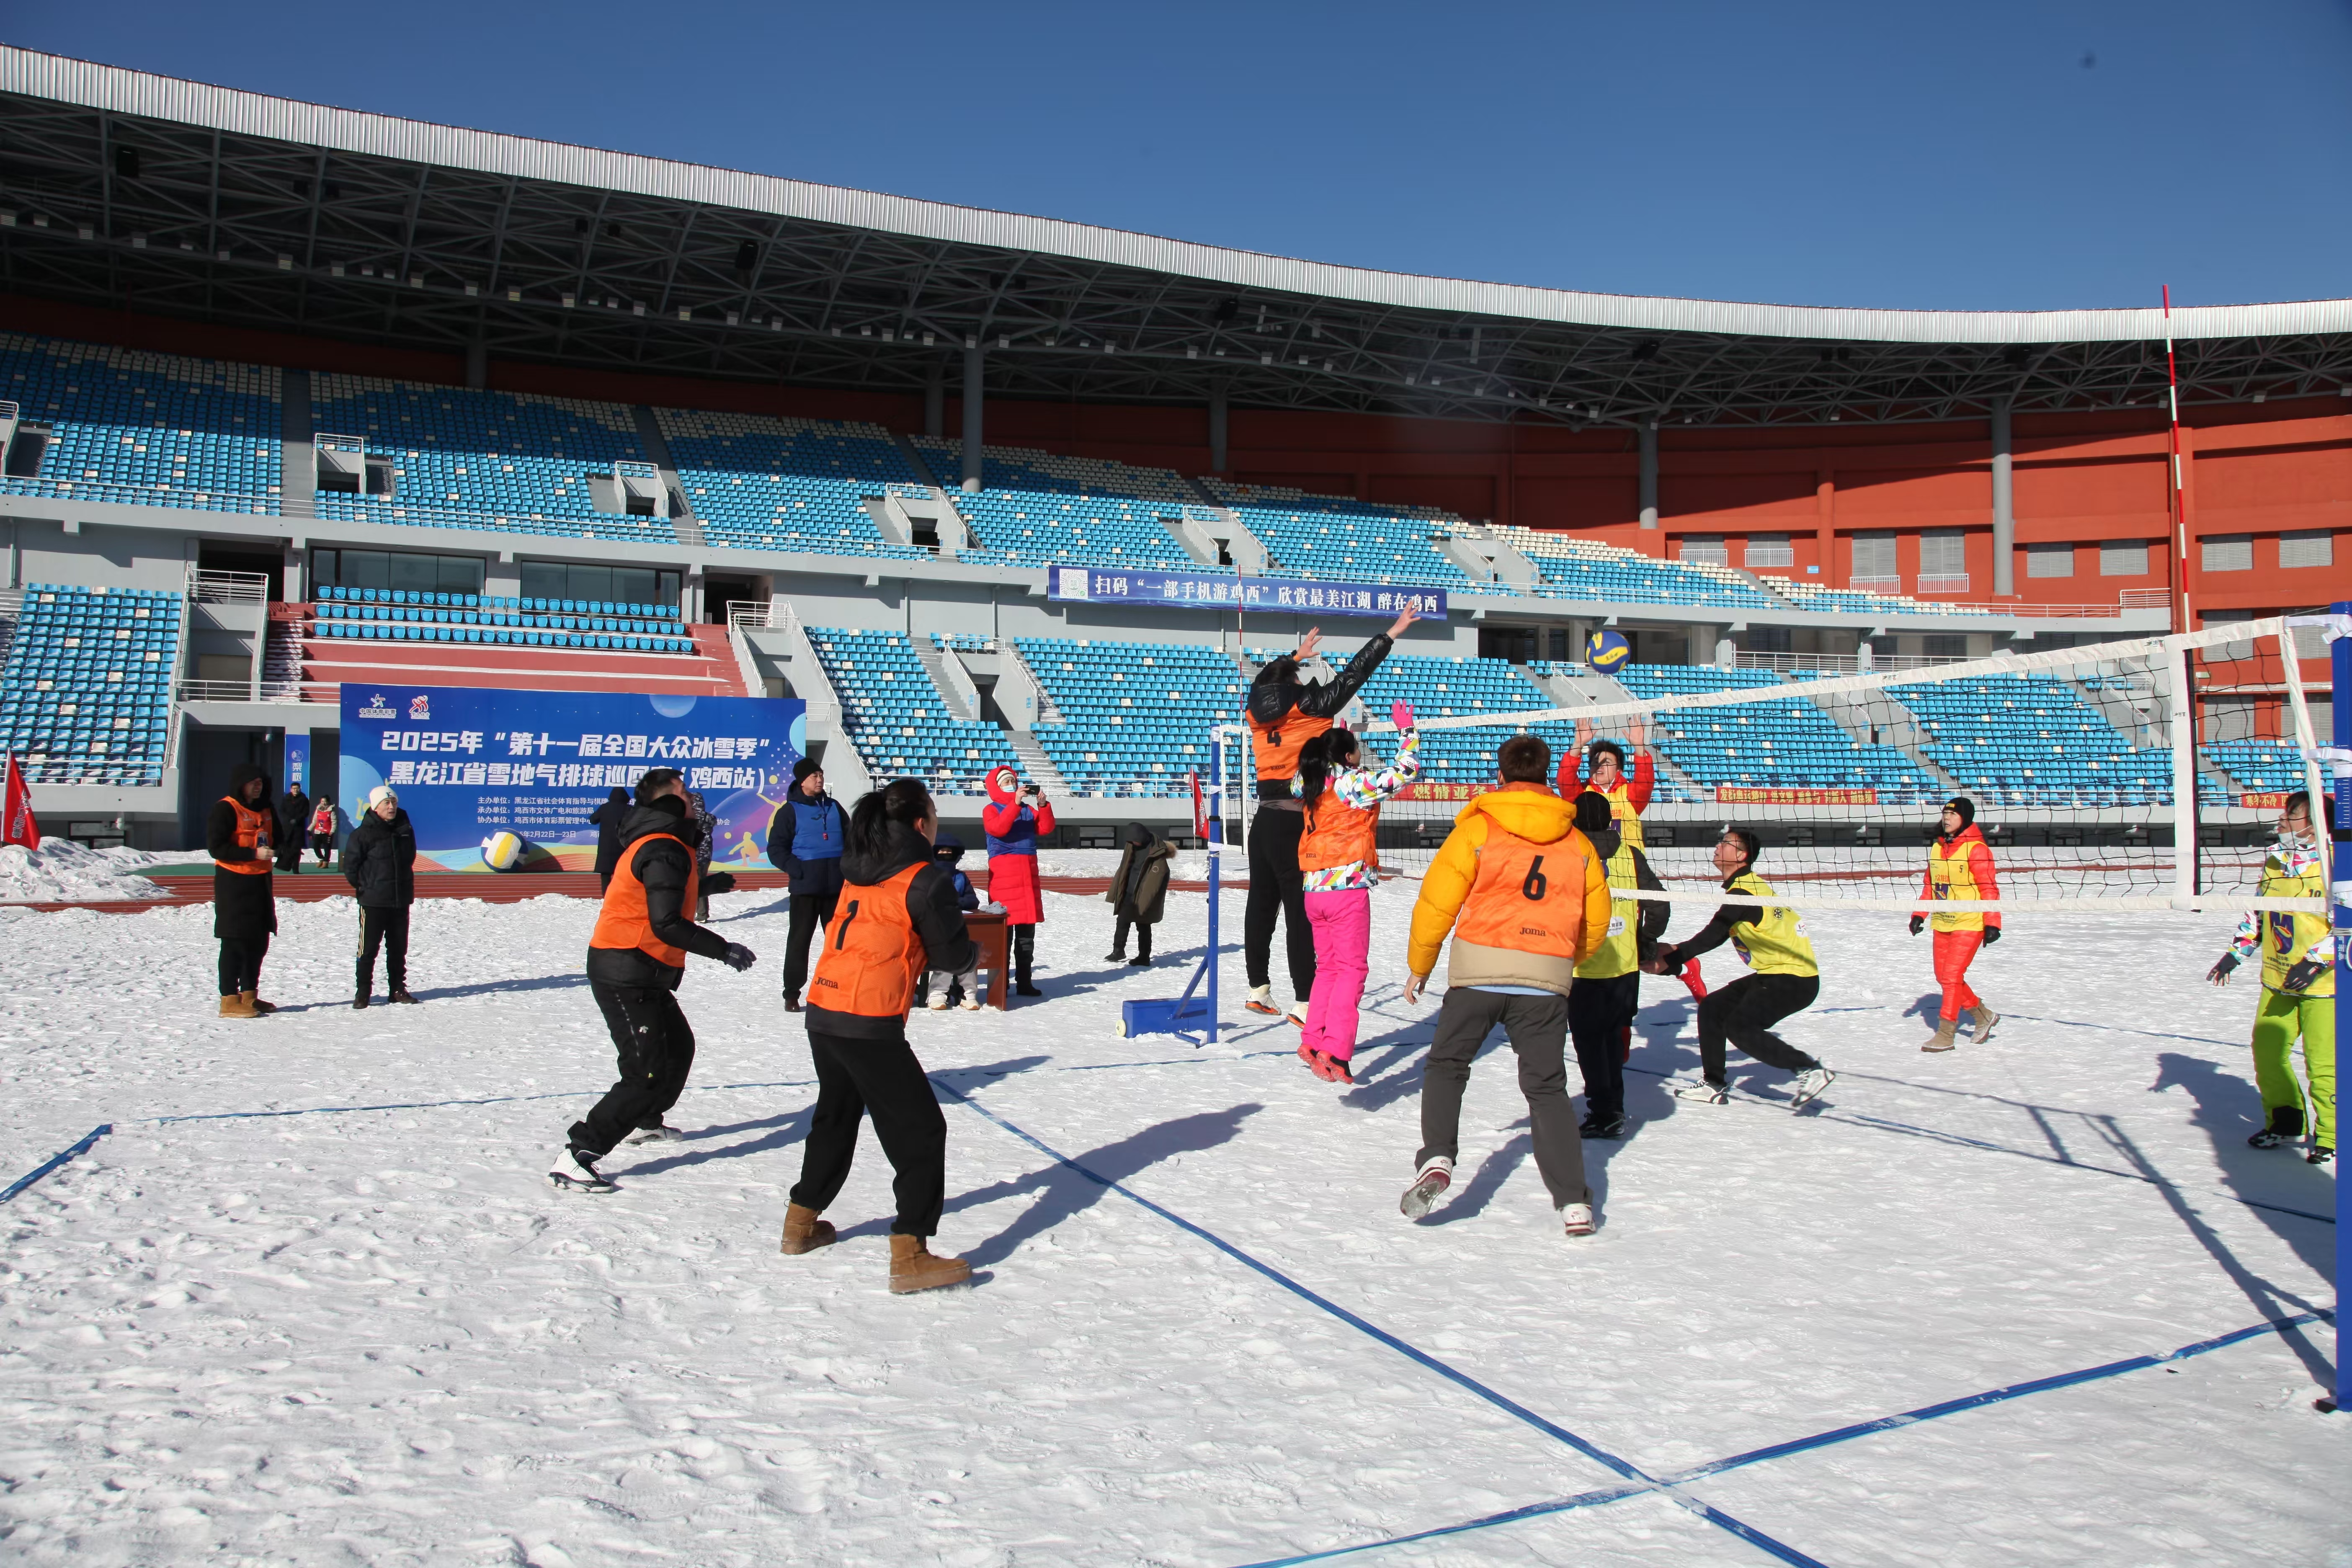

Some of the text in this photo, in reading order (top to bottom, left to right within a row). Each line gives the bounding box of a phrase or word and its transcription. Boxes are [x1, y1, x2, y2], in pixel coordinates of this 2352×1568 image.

[1377, 593, 1437, 612] 醉在鸡西
[1267, 727, 1282, 747] 4
[1720, 789, 1767, 804] 发扬奥运精神
[1771, 790, 1794, 803] 讲文明
[2246, 794, 2277, 807] 寒冬不冷
[1522, 855, 1547, 900] 6
[2308, 889, 2321, 897] 10
[815, 977, 838, 989] Joma
